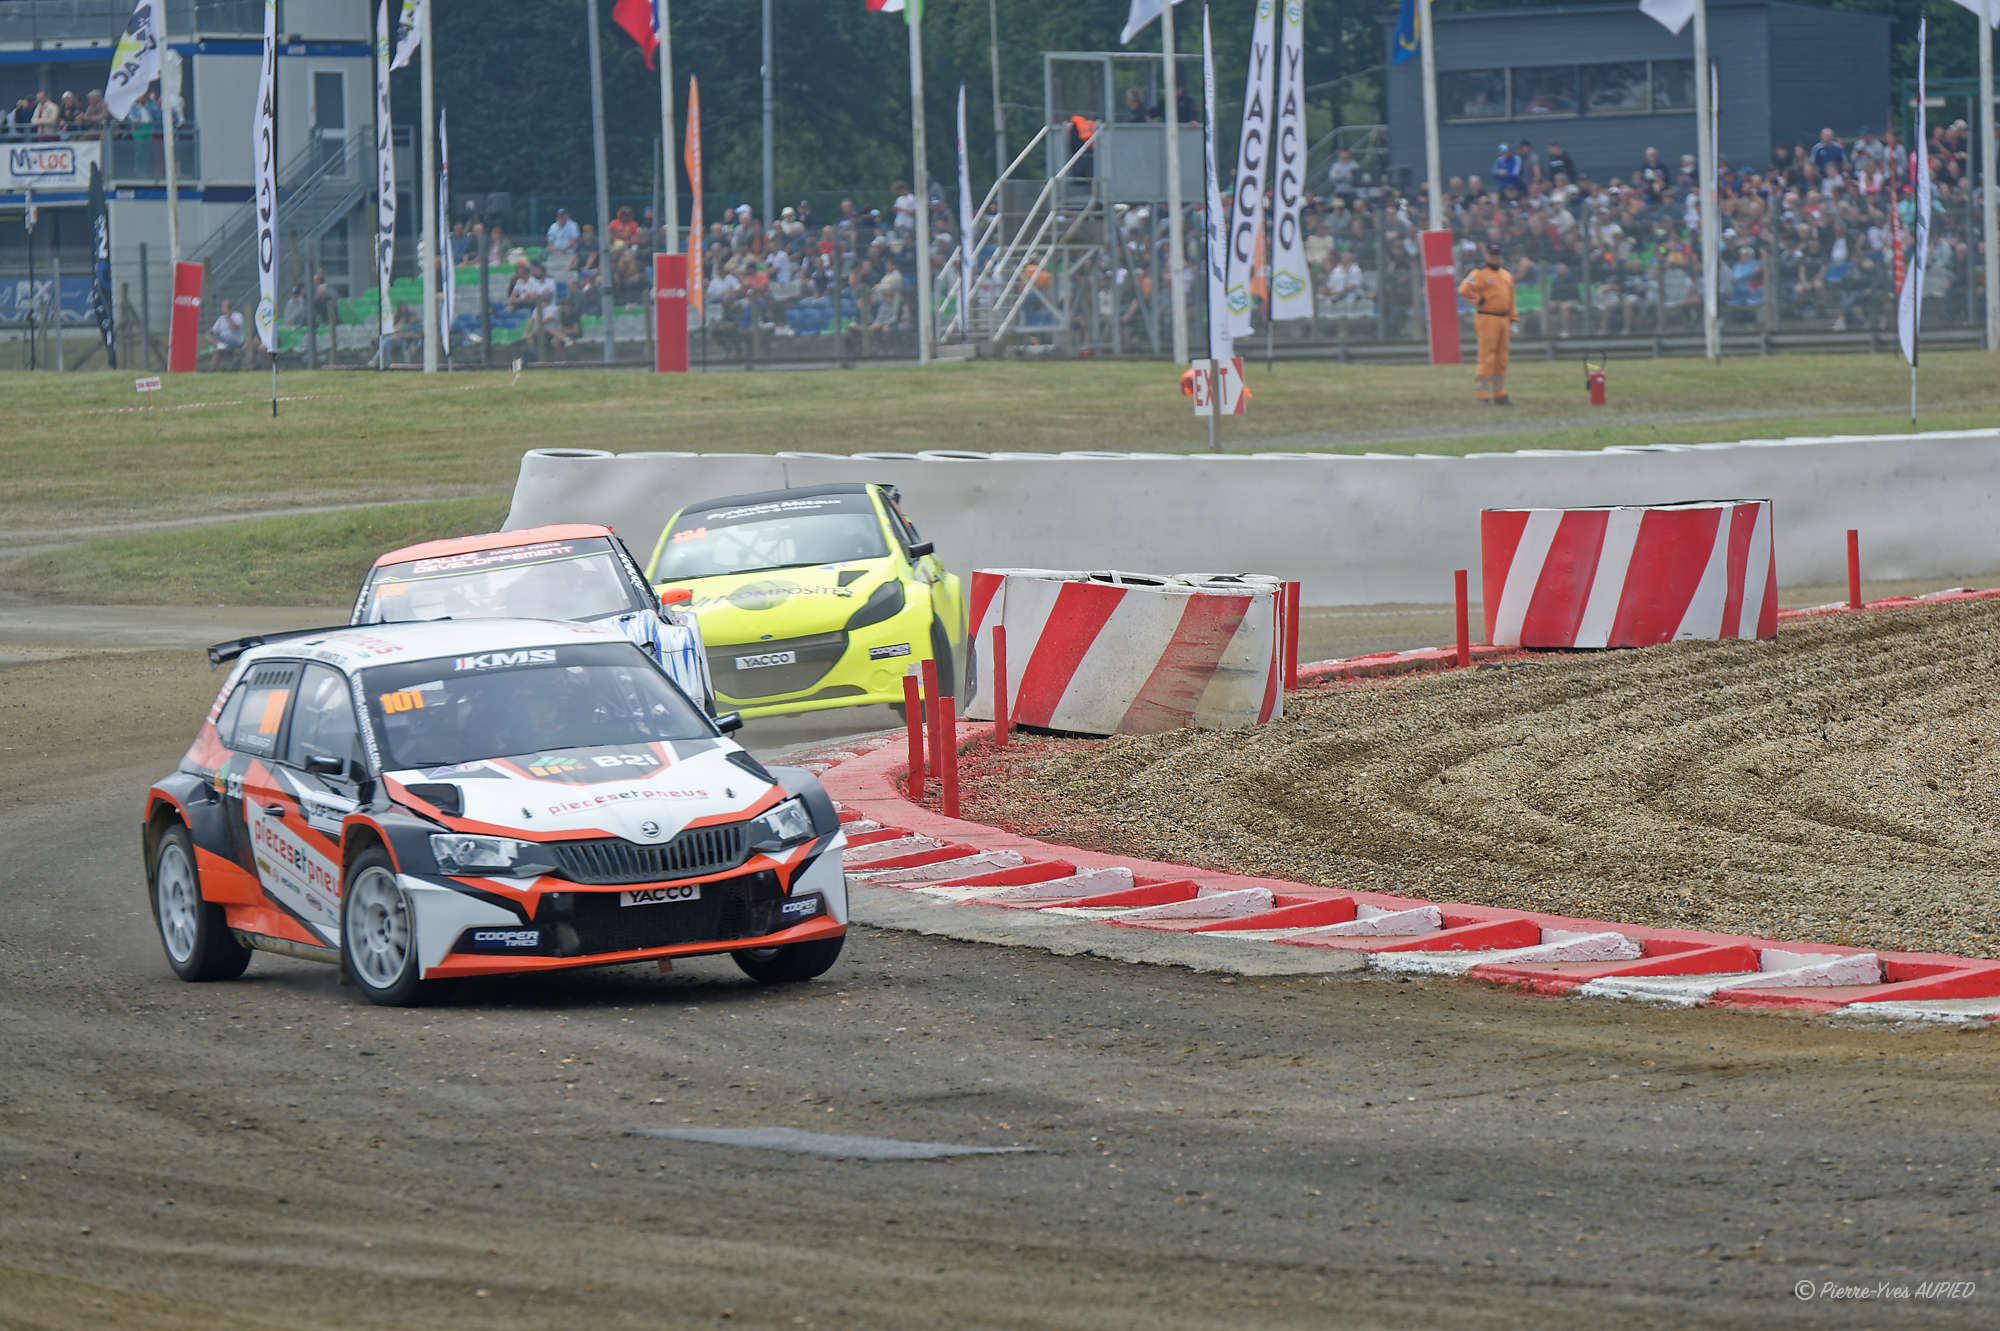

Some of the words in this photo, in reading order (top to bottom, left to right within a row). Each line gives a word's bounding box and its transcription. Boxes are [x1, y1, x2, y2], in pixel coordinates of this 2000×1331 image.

[1280, 44, 1300, 251] YACCO
[1195, 367, 1229, 407] EXT
[463, 649, 557, 670] KMS
[742, 653, 790, 667] YACCO
[379, 690, 424, 715] 101
[630, 885, 693, 903] YACCO
[782, 898, 817, 913] COOPER
[474, 931, 539, 940] COOPER
